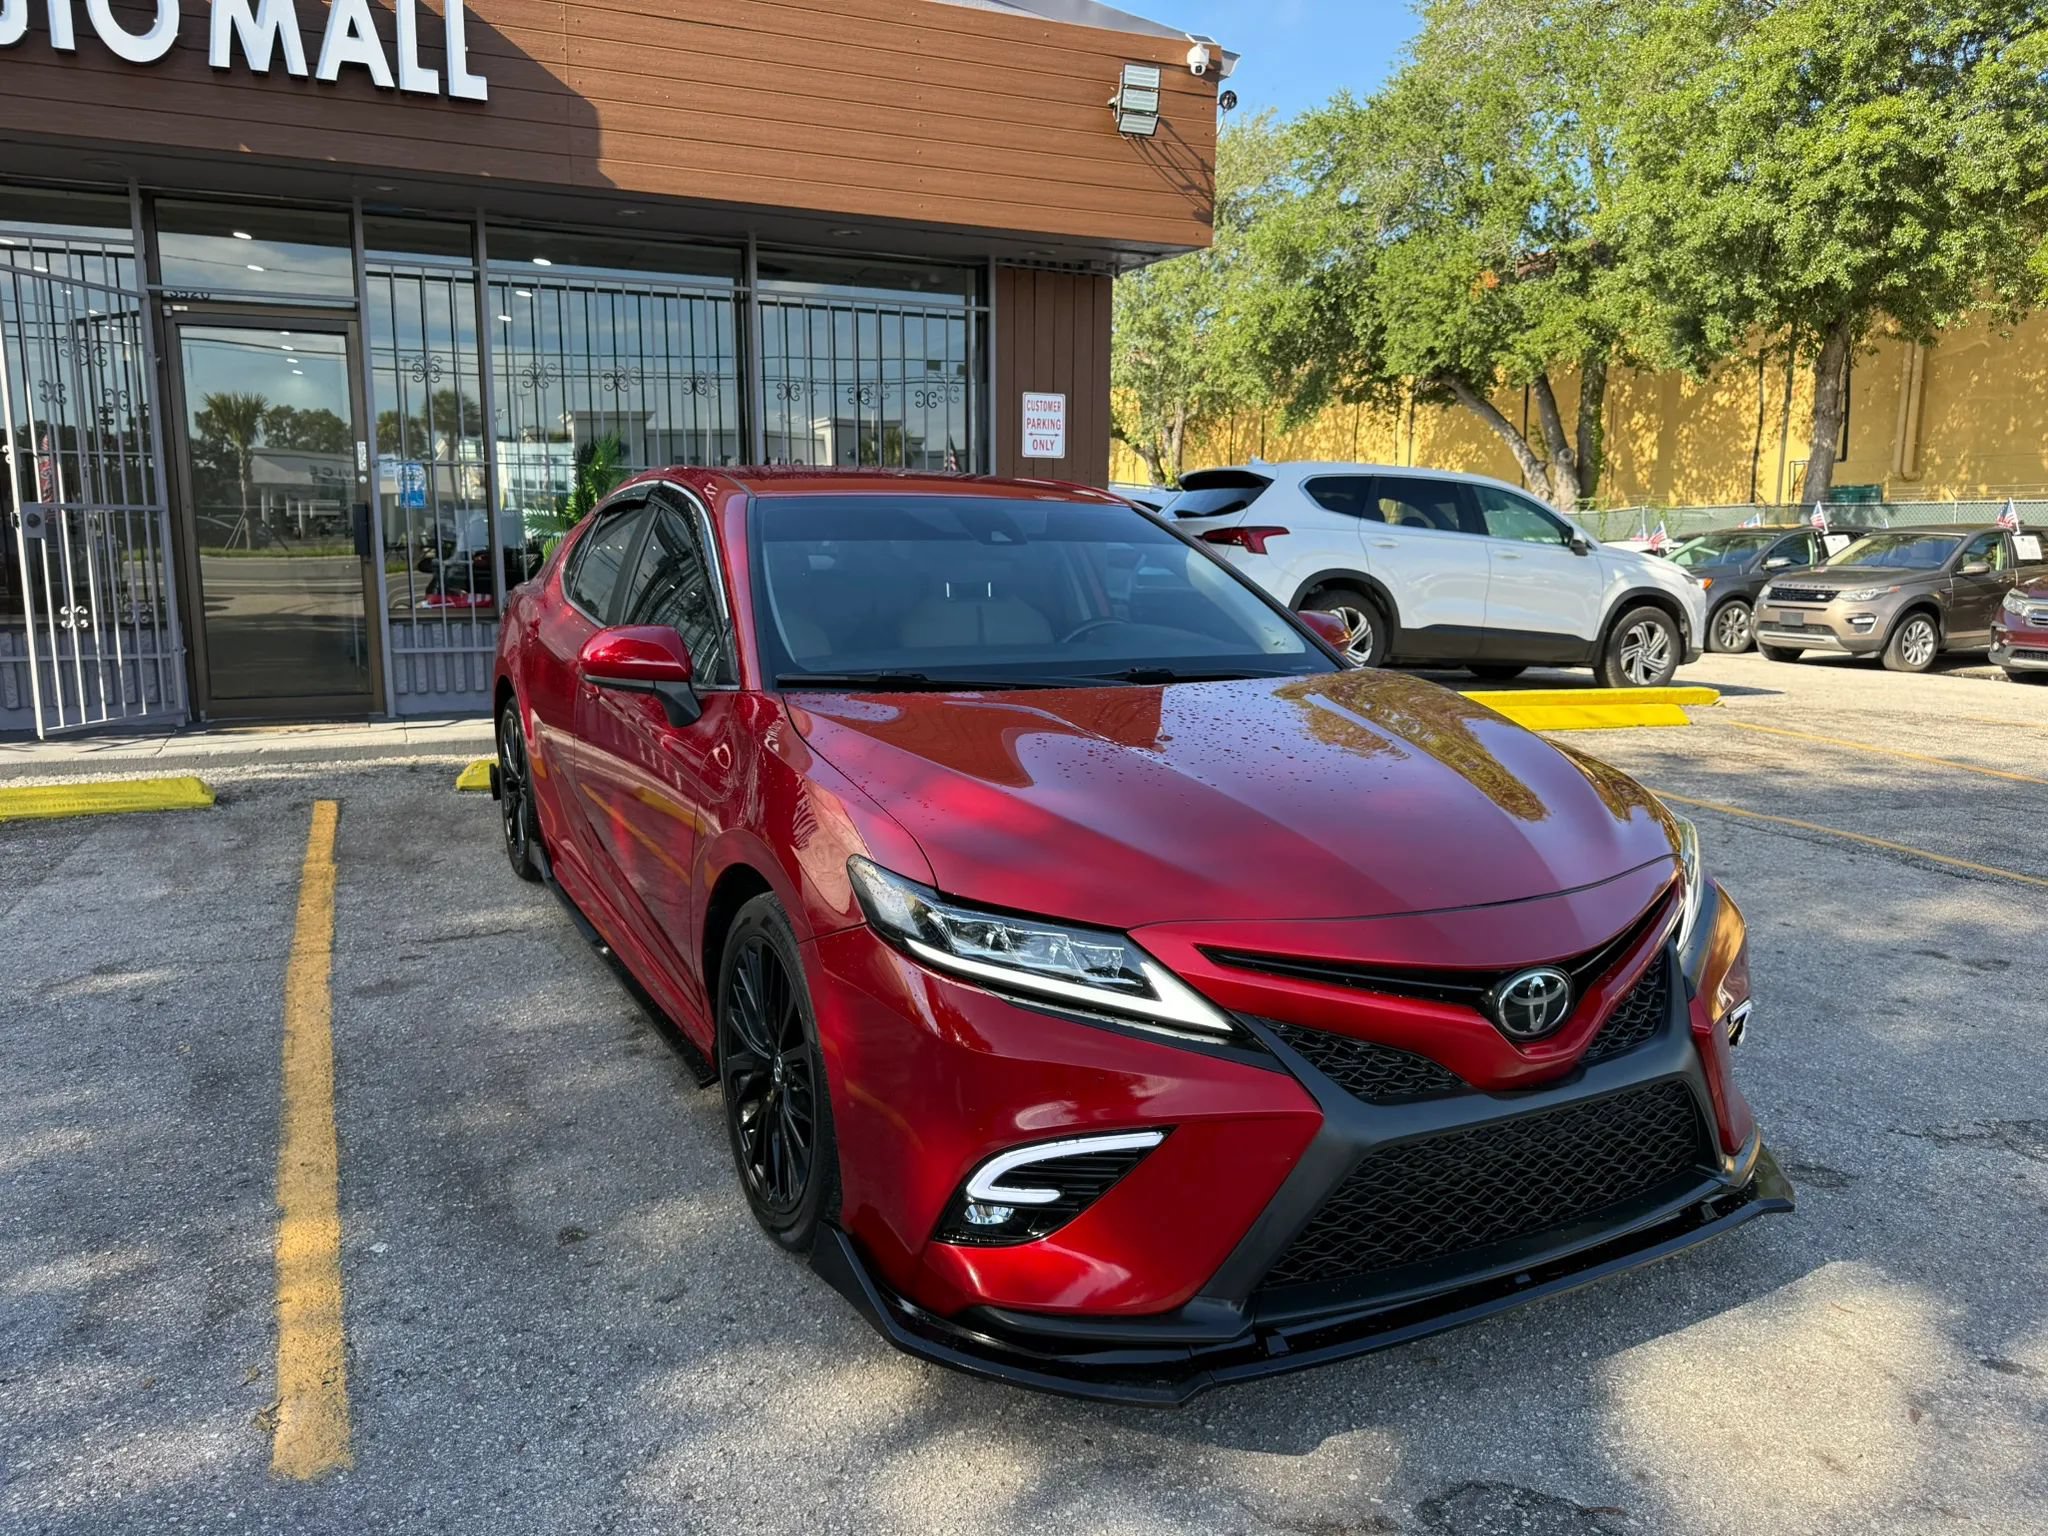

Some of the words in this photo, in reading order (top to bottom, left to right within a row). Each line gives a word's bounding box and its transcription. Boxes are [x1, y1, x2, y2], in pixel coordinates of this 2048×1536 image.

[209, 0, 488, 101] MALL
[1026, 400, 1062, 412] CUSTOMER
[1026, 418, 1061, 430] PARKING
[1032, 439, 1056, 451] ONLY
